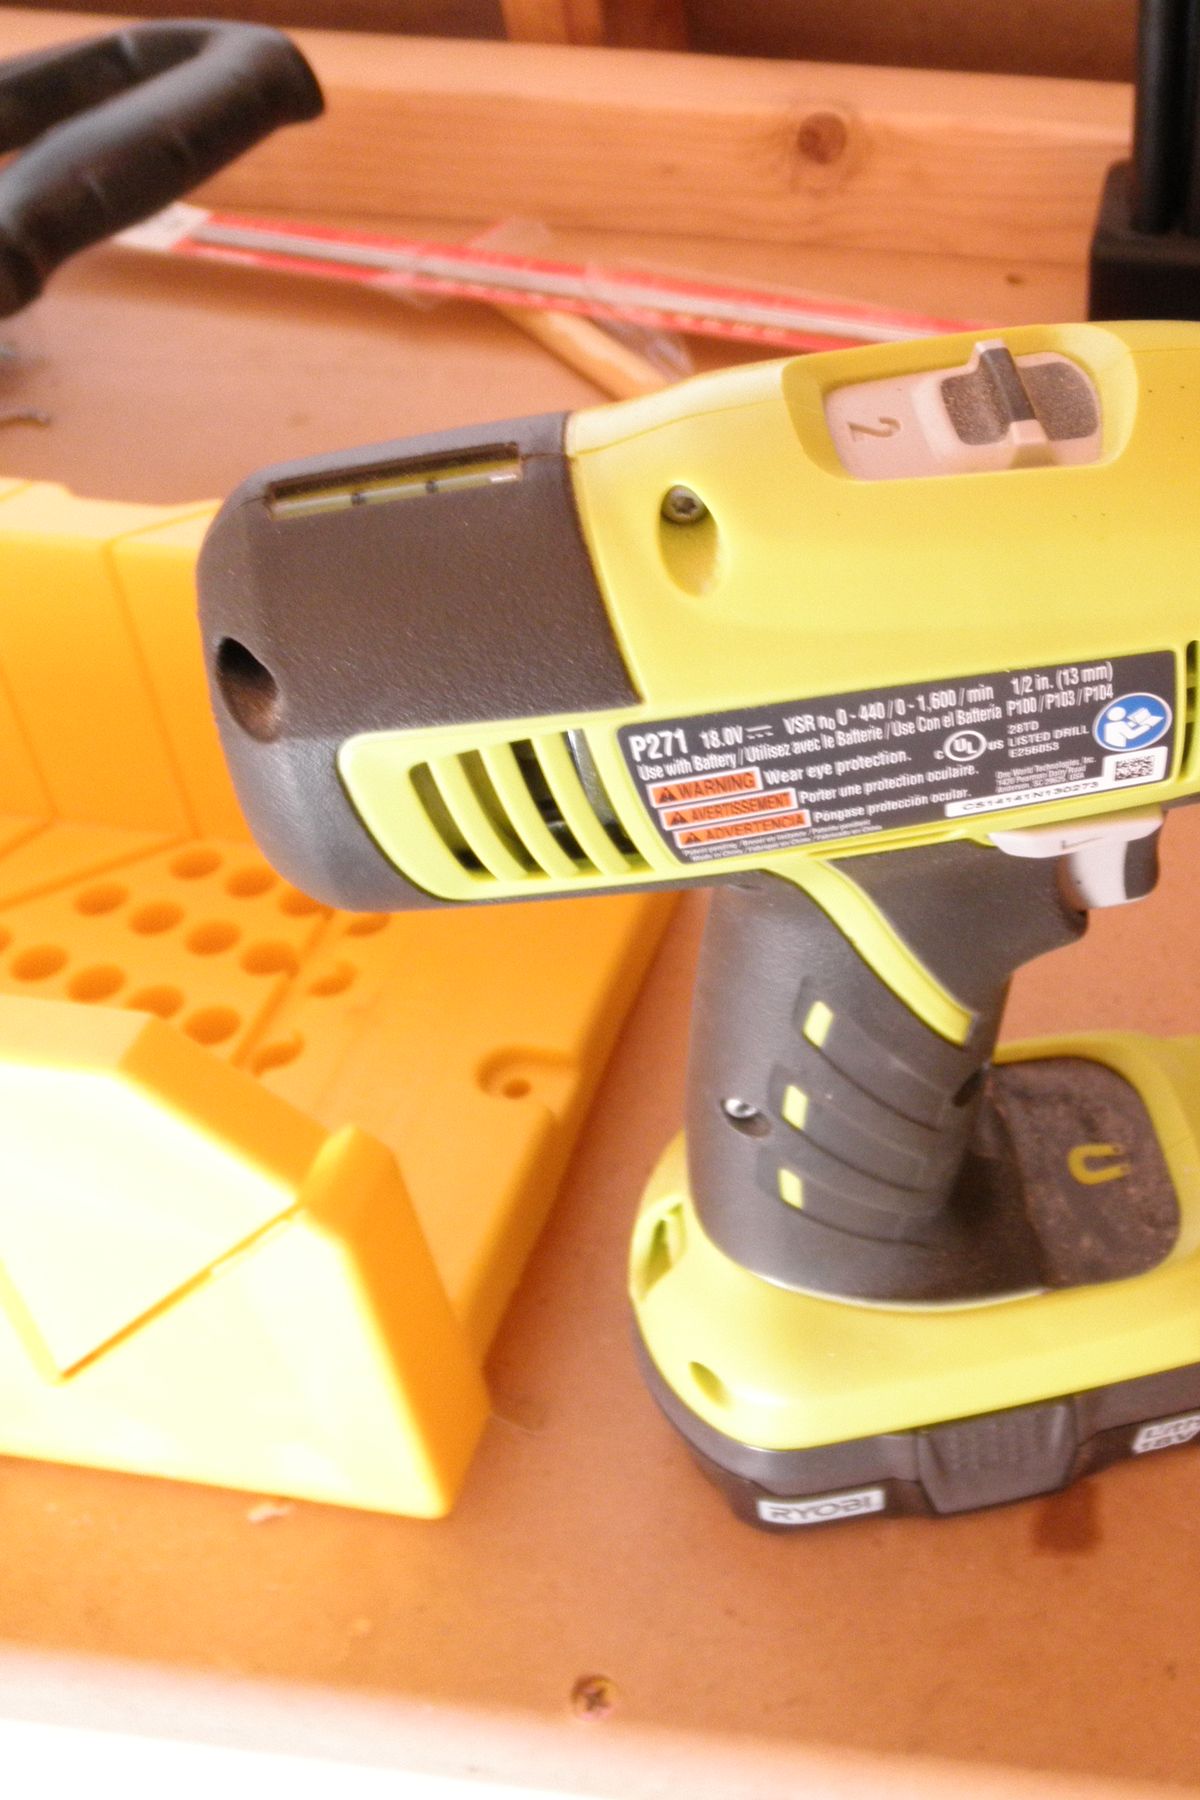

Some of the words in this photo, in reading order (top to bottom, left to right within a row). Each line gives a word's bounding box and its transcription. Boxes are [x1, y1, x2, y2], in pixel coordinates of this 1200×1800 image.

[847, 416, 901, 442] 2
[628, 728, 688, 762] P271
[700, 725, 744, 750] 18.0V
[782, 714, 816, 735] VSR
[858, 702, 886, 722] 440
[916, 689, 957, 713] 1,600
[966, 683, 995, 702] min
[1010, 675, 1033, 696] 1/2
[1034, 674, 1054, 691] in.
[1055, 667, 1080, 691] (13
[1080, 661, 1113, 683] mm)
[637, 763, 664, 781] Use
[664, 758, 693, 777] with
[692, 750, 737, 773] Battery
[745, 743, 791, 763] Utilisez
[791, 737, 821, 755] avec
[821, 733, 835, 750] le
[834, 725, 883, 747] Batterie
[891, 719, 916, 738] Use
[916, 714, 941, 733] Con
[941, 711, 955, 728] el
[1006, 697, 1037, 717] P100
[1045, 690, 1076, 710] P103
[1083, 683, 1114, 703] P104
[1007, 720, 1040, 734] 28TD
[1007, 733, 1051, 748] LISTED
[1052, 725, 1090, 739] DRILL
[679, 772, 754, 798] WARNING
[763, 768, 803, 785] Wear
[806, 764, 833, 780] eye
[834, 750, 912, 776] protection.
[692, 792, 790, 820] AVERTISSEMENT
[799, 788, 837, 804] Porter
[838, 784, 862, 797] une
[863, 773, 925, 796] protection
[926, 764, 979, 782] oculaire.
[706, 815, 805, 840] ADVERTENCIA
[814, 804, 864, 823] Póngase
[930, 788, 972, 804] ocular.
[768, 1495, 871, 1520] RYOBI
